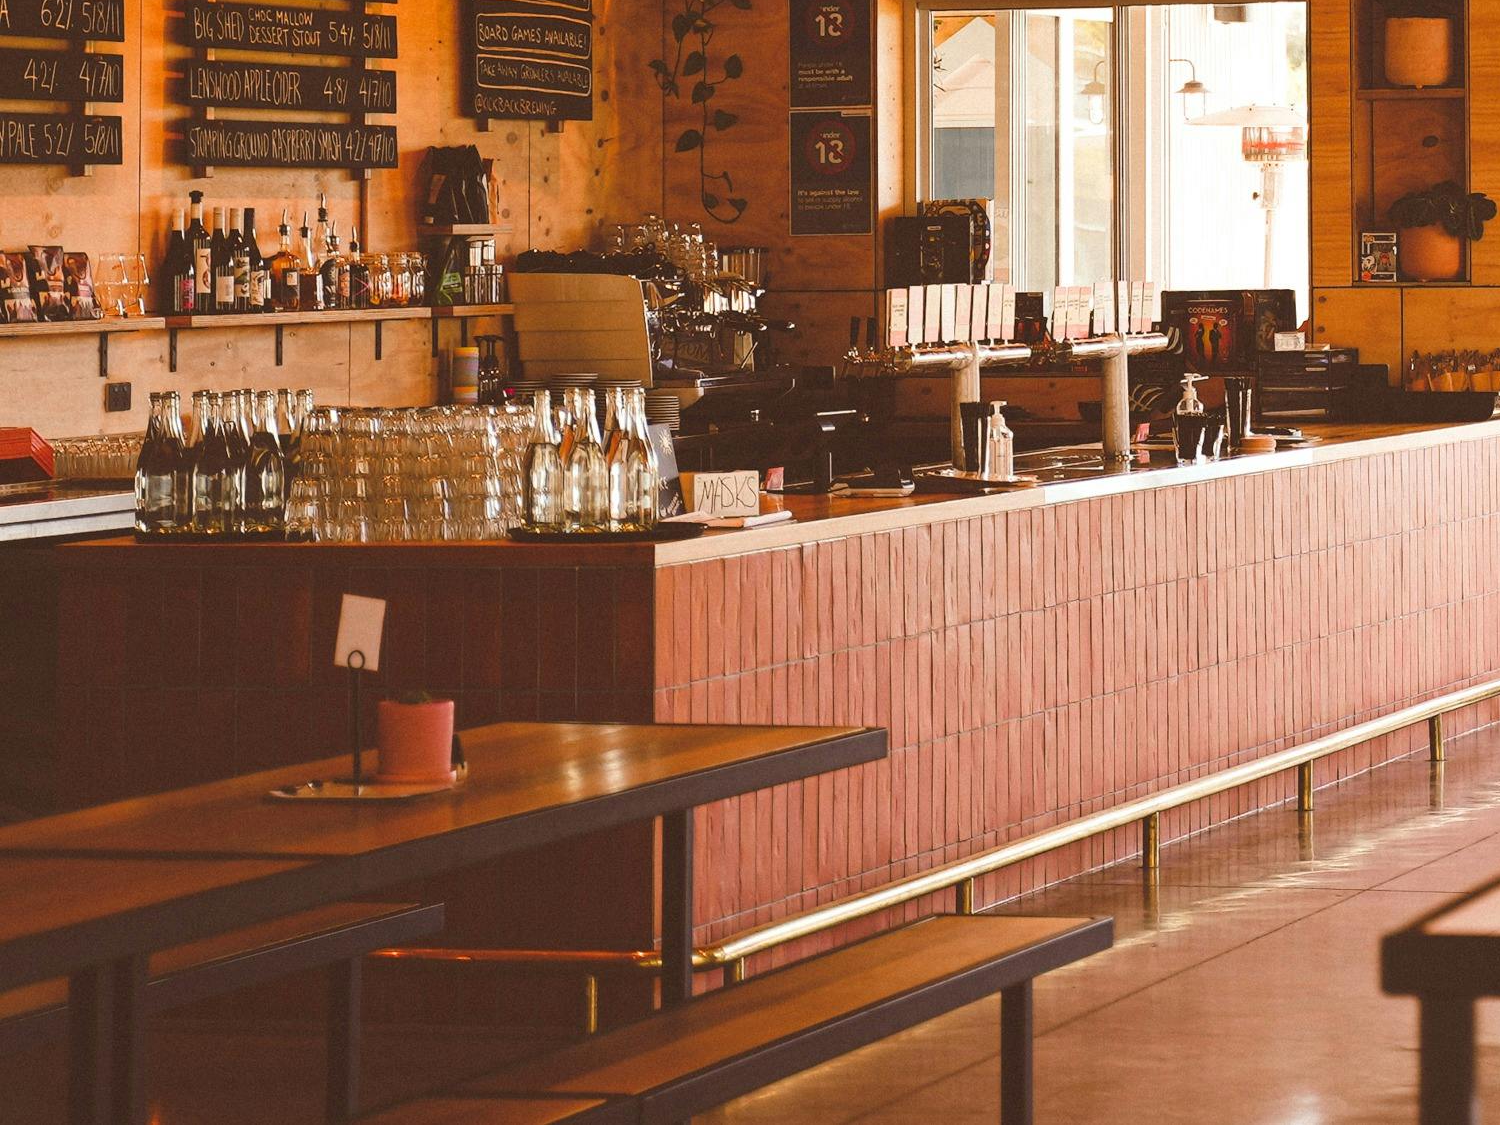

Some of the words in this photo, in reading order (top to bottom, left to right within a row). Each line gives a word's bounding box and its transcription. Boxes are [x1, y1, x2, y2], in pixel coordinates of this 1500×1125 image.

[194, 6, 214, 42] BIG
[216, 9, 245, 42] SHED
[248, 7, 273, 22] CHOC
[276, 10, 313, 26] MALLOW
[248, 25, 289, 47] DESSERT
[292, 28, 321, 47] STOUT
[478, 23, 508, 42] BOARD
[511, 25, 541, 43] GAMES
[190, 67, 242, 101] LENSWOOD
[244, 69, 271, 102] APPLE
[272, 70, 302, 105] CIDER
[8, 121, 38, 158] PALE
[190, 126, 232, 159] STOMPING
[233, 131, 269, 160] GROUND
[271, 128, 317, 163] RASPBERRY
[1188, 306, 1228, 315] CODENAMES
[698, 475, 757, 514] MASKS
